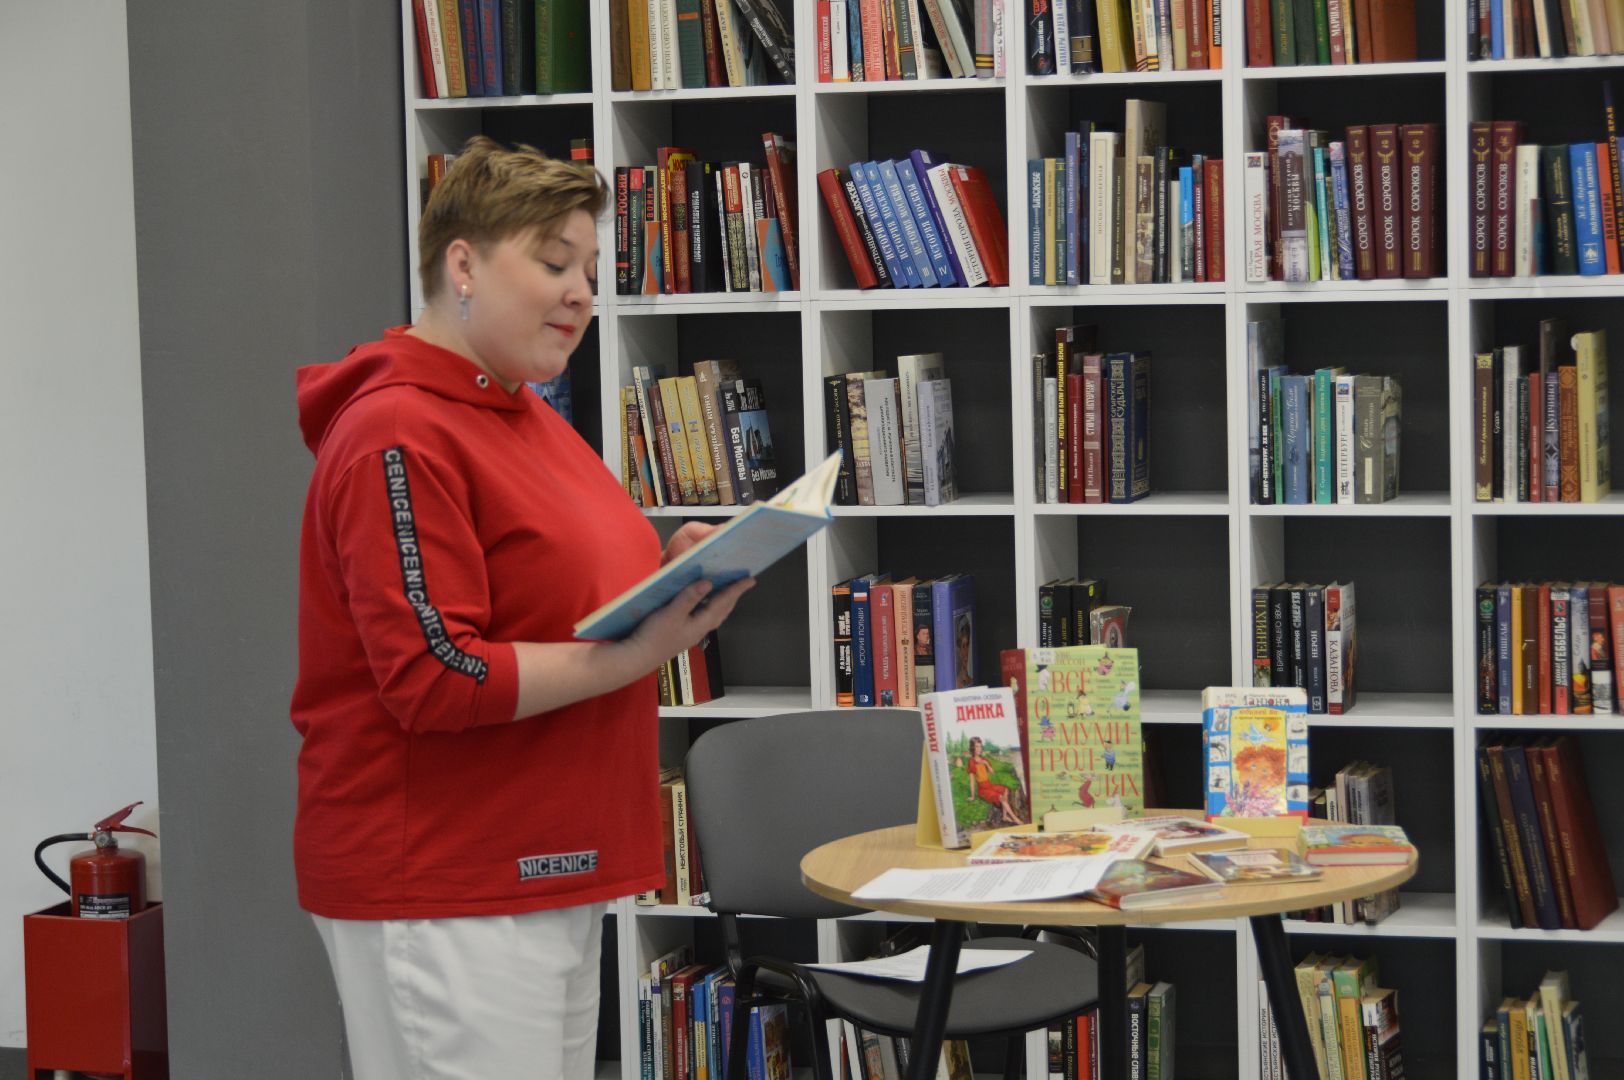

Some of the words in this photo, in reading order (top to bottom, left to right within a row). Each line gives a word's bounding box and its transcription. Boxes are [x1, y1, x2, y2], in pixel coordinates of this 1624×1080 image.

[617, 173, 628, 215] РОССИИ
[859, 183, 878, 220] МОСКВЫ
[872, 183, 893, 220] МОСКВЫ
[889, 183, 909, 220] МОСКВЫ
[907, 182, 926, 218] МОСКВЫ
[938, 167, 956, 206] МОСКВЫ
[1354, 164, 1366, 211] СОРОКОВ
[1381, 165, 1392, 211] СОРОКОВ
[1411, 165, 1421, 212] СОРОКОВ
[1476, 163, 1486, 211] СОРОКОВ
[1498, 163, 1508, 210] СОРОКОВ
[1252, 193, 1263, 235] МОСКВА
[1358, 216, 1369, 250] СОРОК
[1385, 216, 1394, 250] СОРОК
[1411, 216, 1421, 250] СОРОК
[1476, 215, 1486, 249] СОРОК
[1498, 214, 1508, 249] СОРОК
[873, 221, 895, 261] ИСТОРИЯ
[887, 221, 909, 261] ИСТОРИЯ
[902, 218, 923, 257] ИСТОРИЯ
[921, 220, 943, 261] ИСТОРИЯ
[1032, 227, 1041, 278] ИНОСТРАНЦЫ
[1253, 239, 1264, 278] СТАРАЯ
[1546, 382, 1557, 430] Купчино
[730, 427, 740, 444] Без
[1340, 432, 1348, 478] ПЕТЕРБУРГ
[734, 445, 747, 481] Москвы
[1255, 611, 1268, 659] ГЕНРИХ
[1310, 630, 1318, 658] НЕРОН
[1500, 622, 1508, 660] РИШЕЛЬЕ
[1554, 616, 1567, 662] ГЕББЕЛЬС
[1329, 640, 1339, 693] КАЗАНОВА
[924, 701, 939, 753] ДИНКА
[956, 703, 1005, 722] ДИНКА
[1034, 696, 1051, 720] О
[1059, 720, 1138, 747] МУМИ-
[1034, 747, 1102, 772] ТРОЛ-
[1094, 772, 1141, 798] ЛЯХ
[520, 853, 598, 877] NICENICE
[678, 828, 686, 870] НЕИСТОВЫЙ
